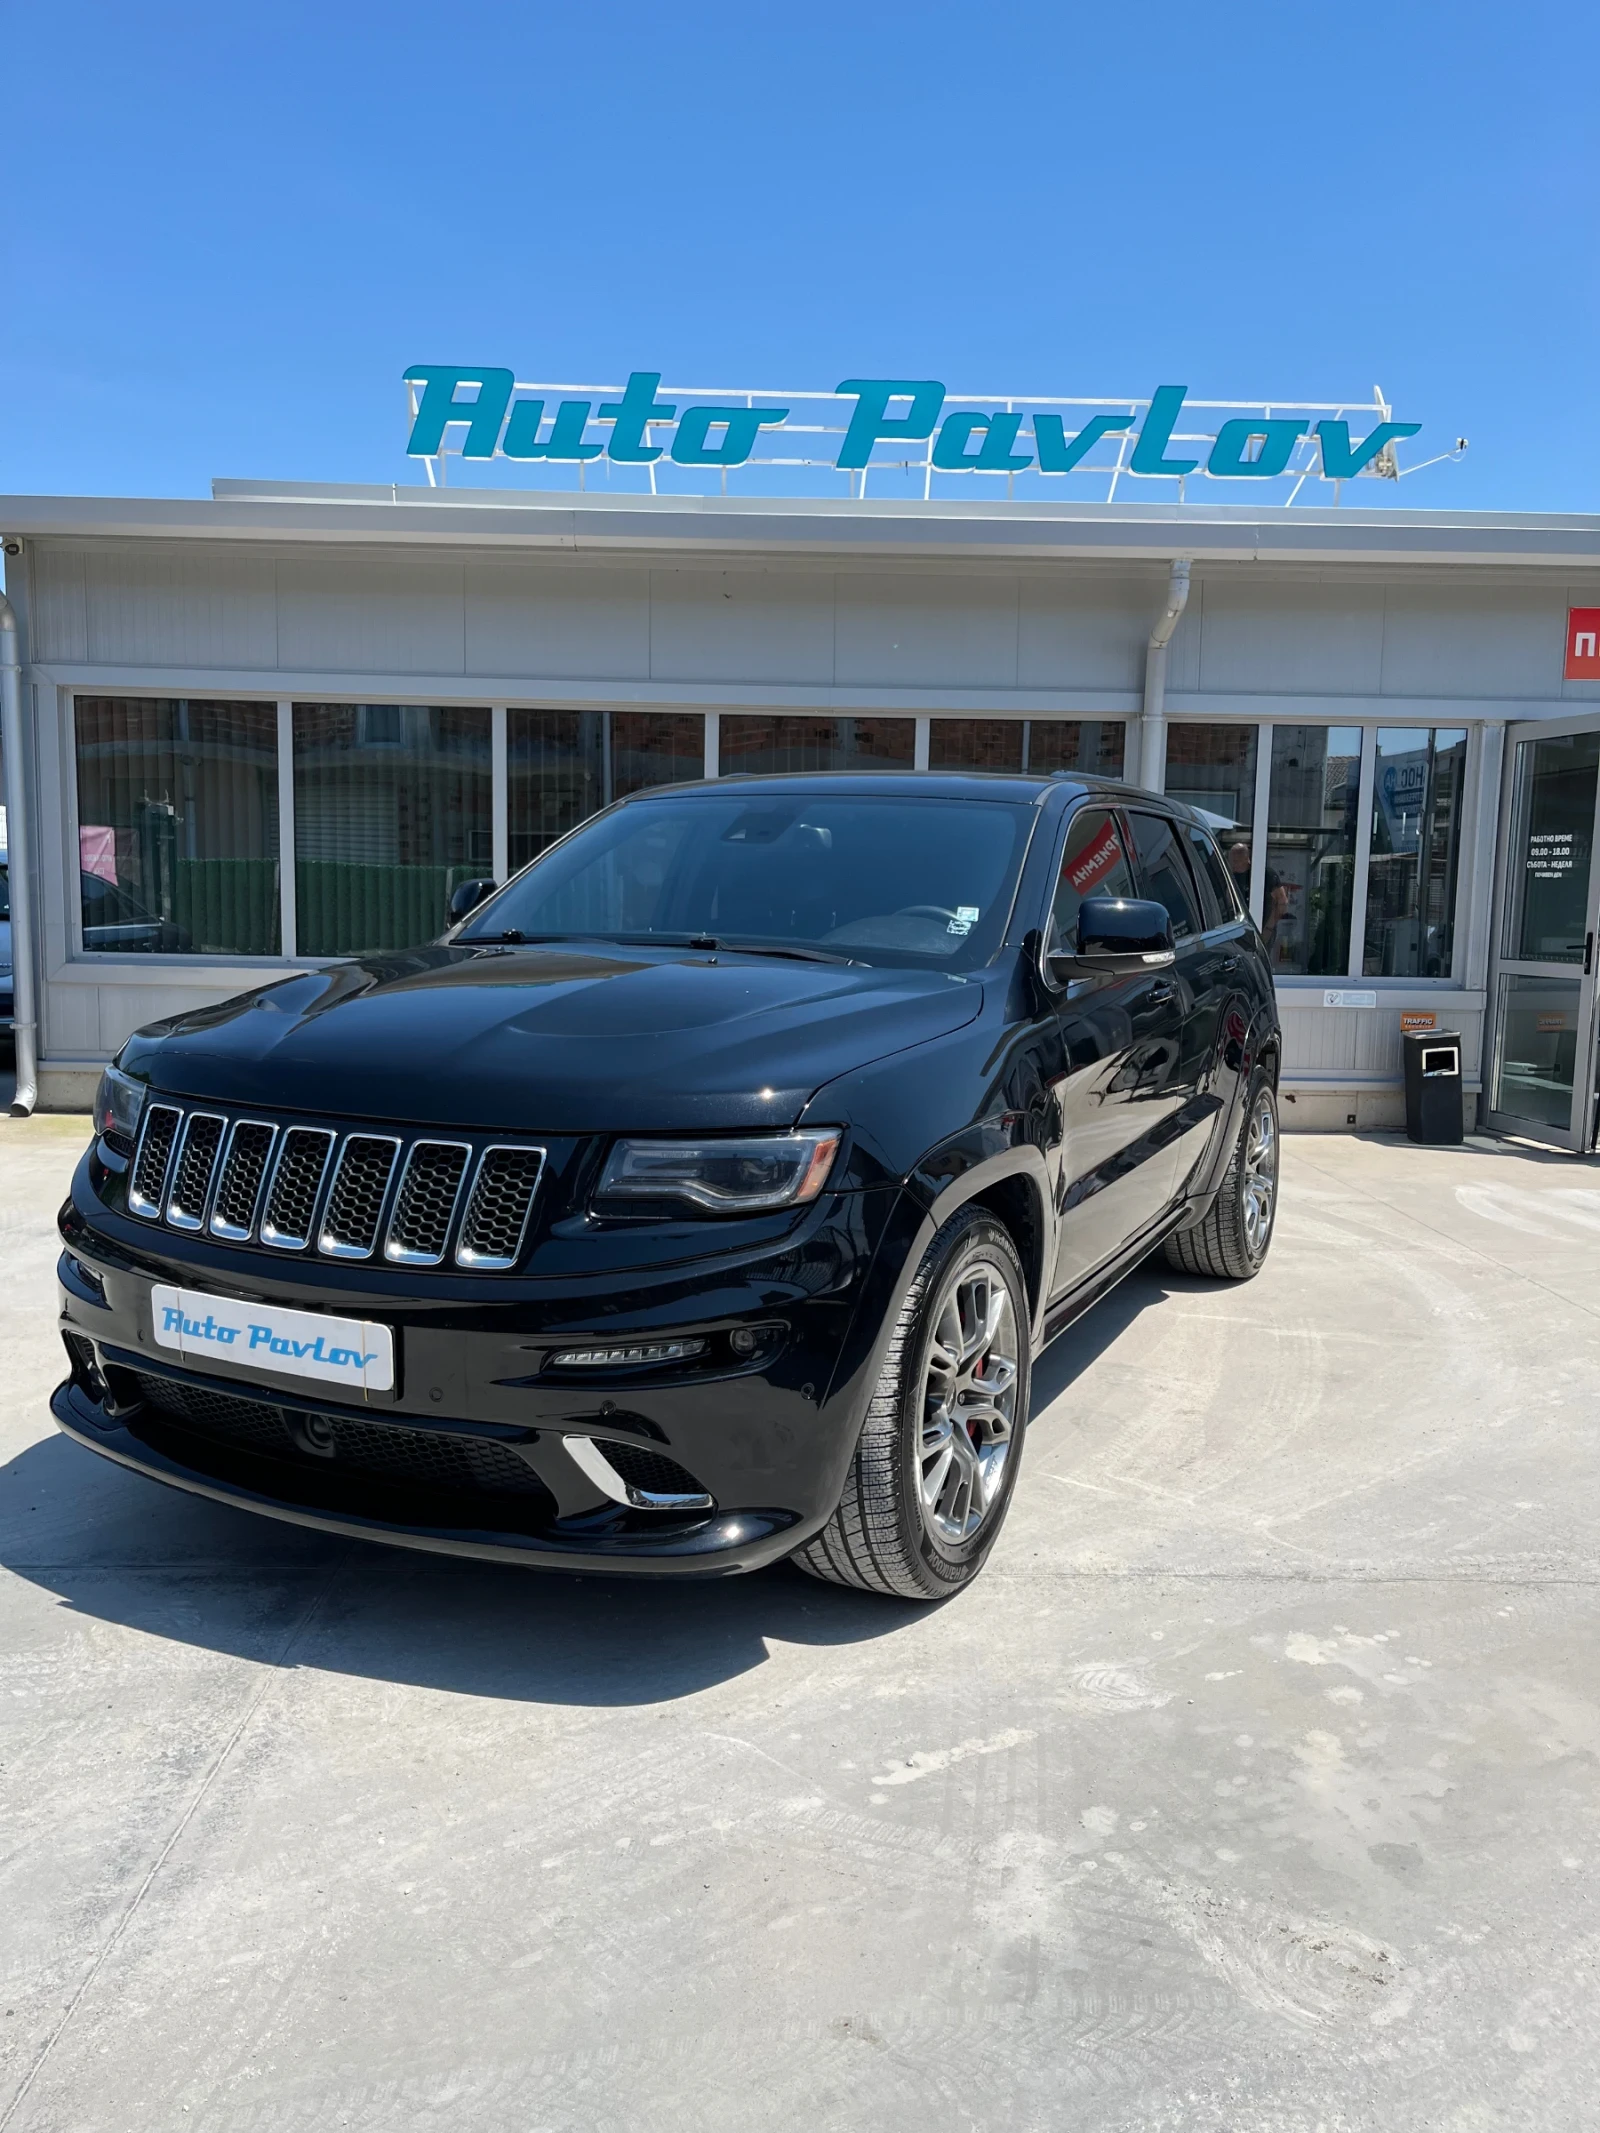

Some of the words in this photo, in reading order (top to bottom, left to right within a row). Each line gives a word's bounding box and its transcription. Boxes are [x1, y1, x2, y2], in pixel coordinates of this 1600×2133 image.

[402, 365, 790, 468] Auto
[835, 380, 1423, 478] Pavlov
[1575, 632, 1600, 657] П
[1531, 835, 1554, 843] РАБОТНО
[1554, 834, 1573, 842] ВРЕМЕ
[1531, 848, 1548, 856] 09.00
[1552, 847, 1570, 856] 18.00
[1526, 861, 1547, 869] СЪБОТА
[1551, 861, 1573, 869] НЕДЕЛЯ
[1403, 1017, 1433, 1026] TRAFFIC
[162, 1307, 241, 1344] Auto
[248, 1324, 378, 1369] Pavlov
